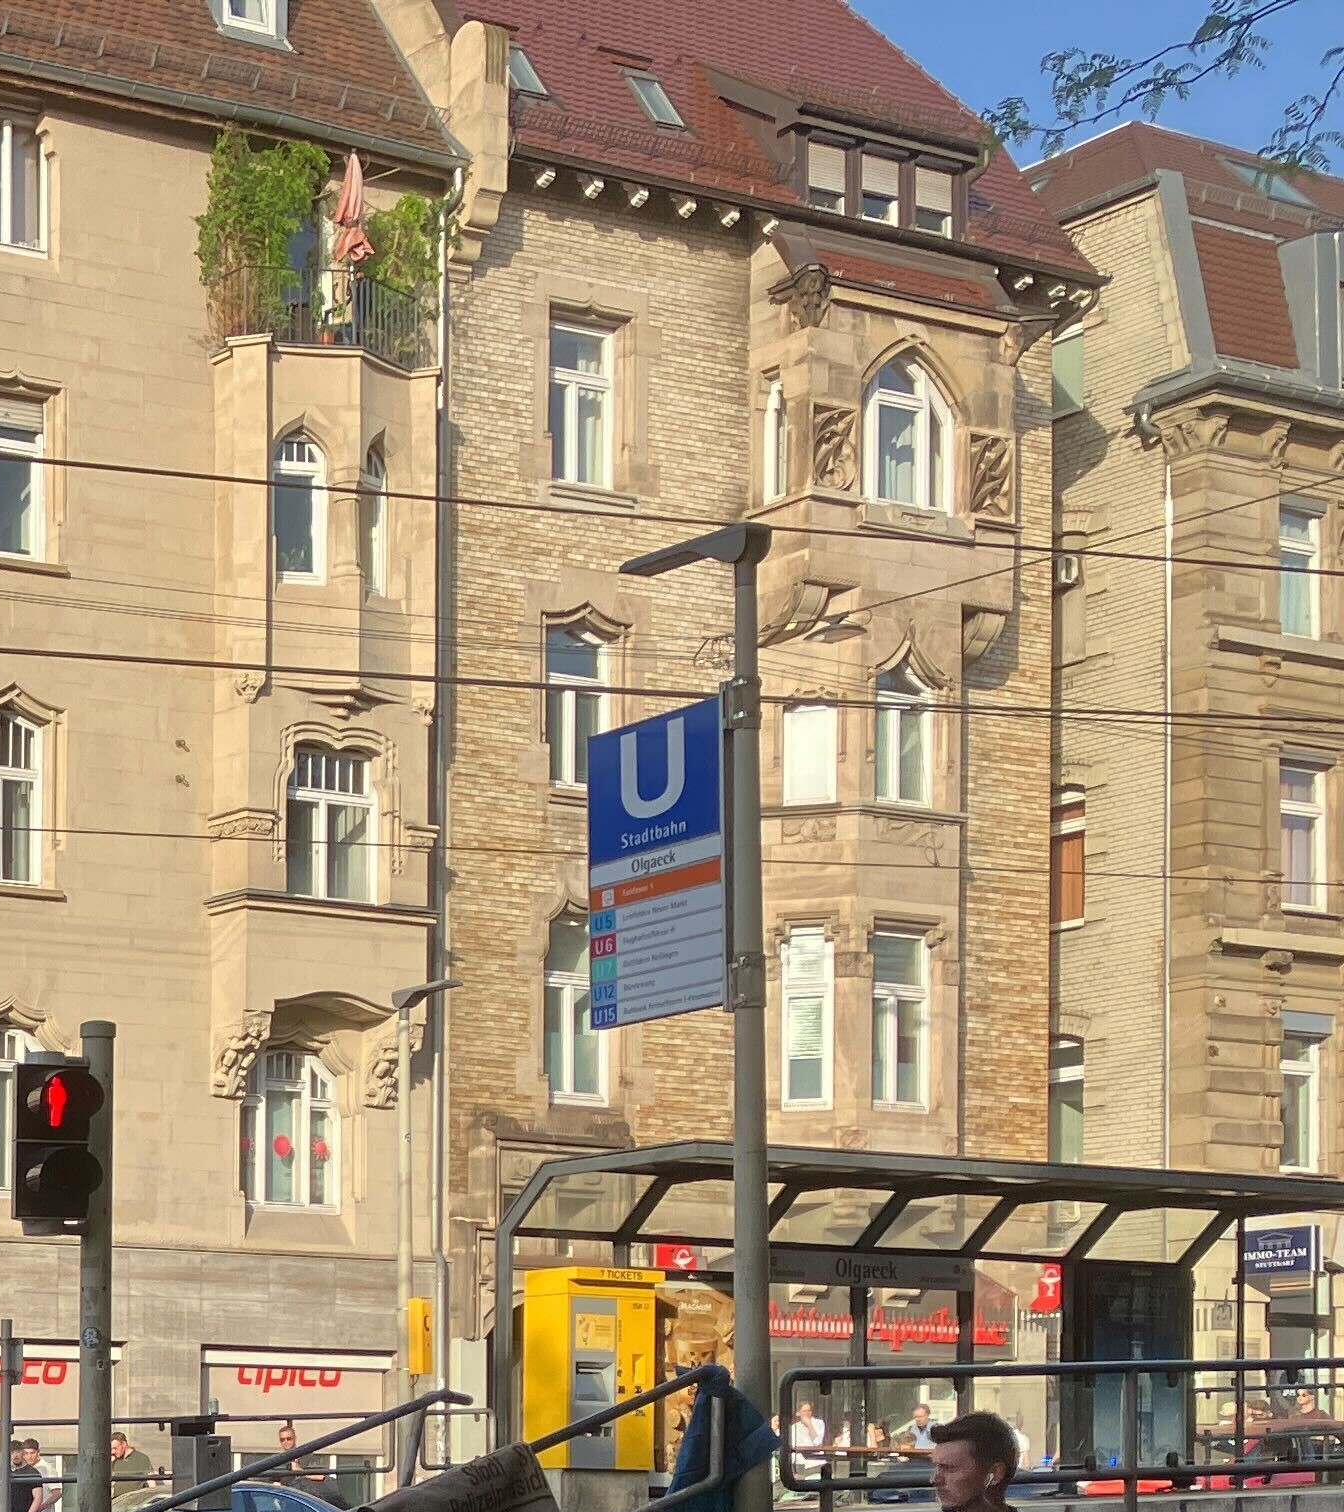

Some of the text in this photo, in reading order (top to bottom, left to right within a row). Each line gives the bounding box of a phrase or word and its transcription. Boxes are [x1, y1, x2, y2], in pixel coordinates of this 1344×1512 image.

[620, 716, 685, 819] U
[621, 821, 687, 849] Stadtbahn
[631, 851, 676, 875] Olgaeck
[593, 984, 614, 1001] U12
[593, 1008, 616, 1024] U15
[1243, 1247, 1307, 1261] IMMO-TEAM
[606, 1269, 643, 1281] TICKETS
[835, 1257, 898, 1282] Olgaeck
